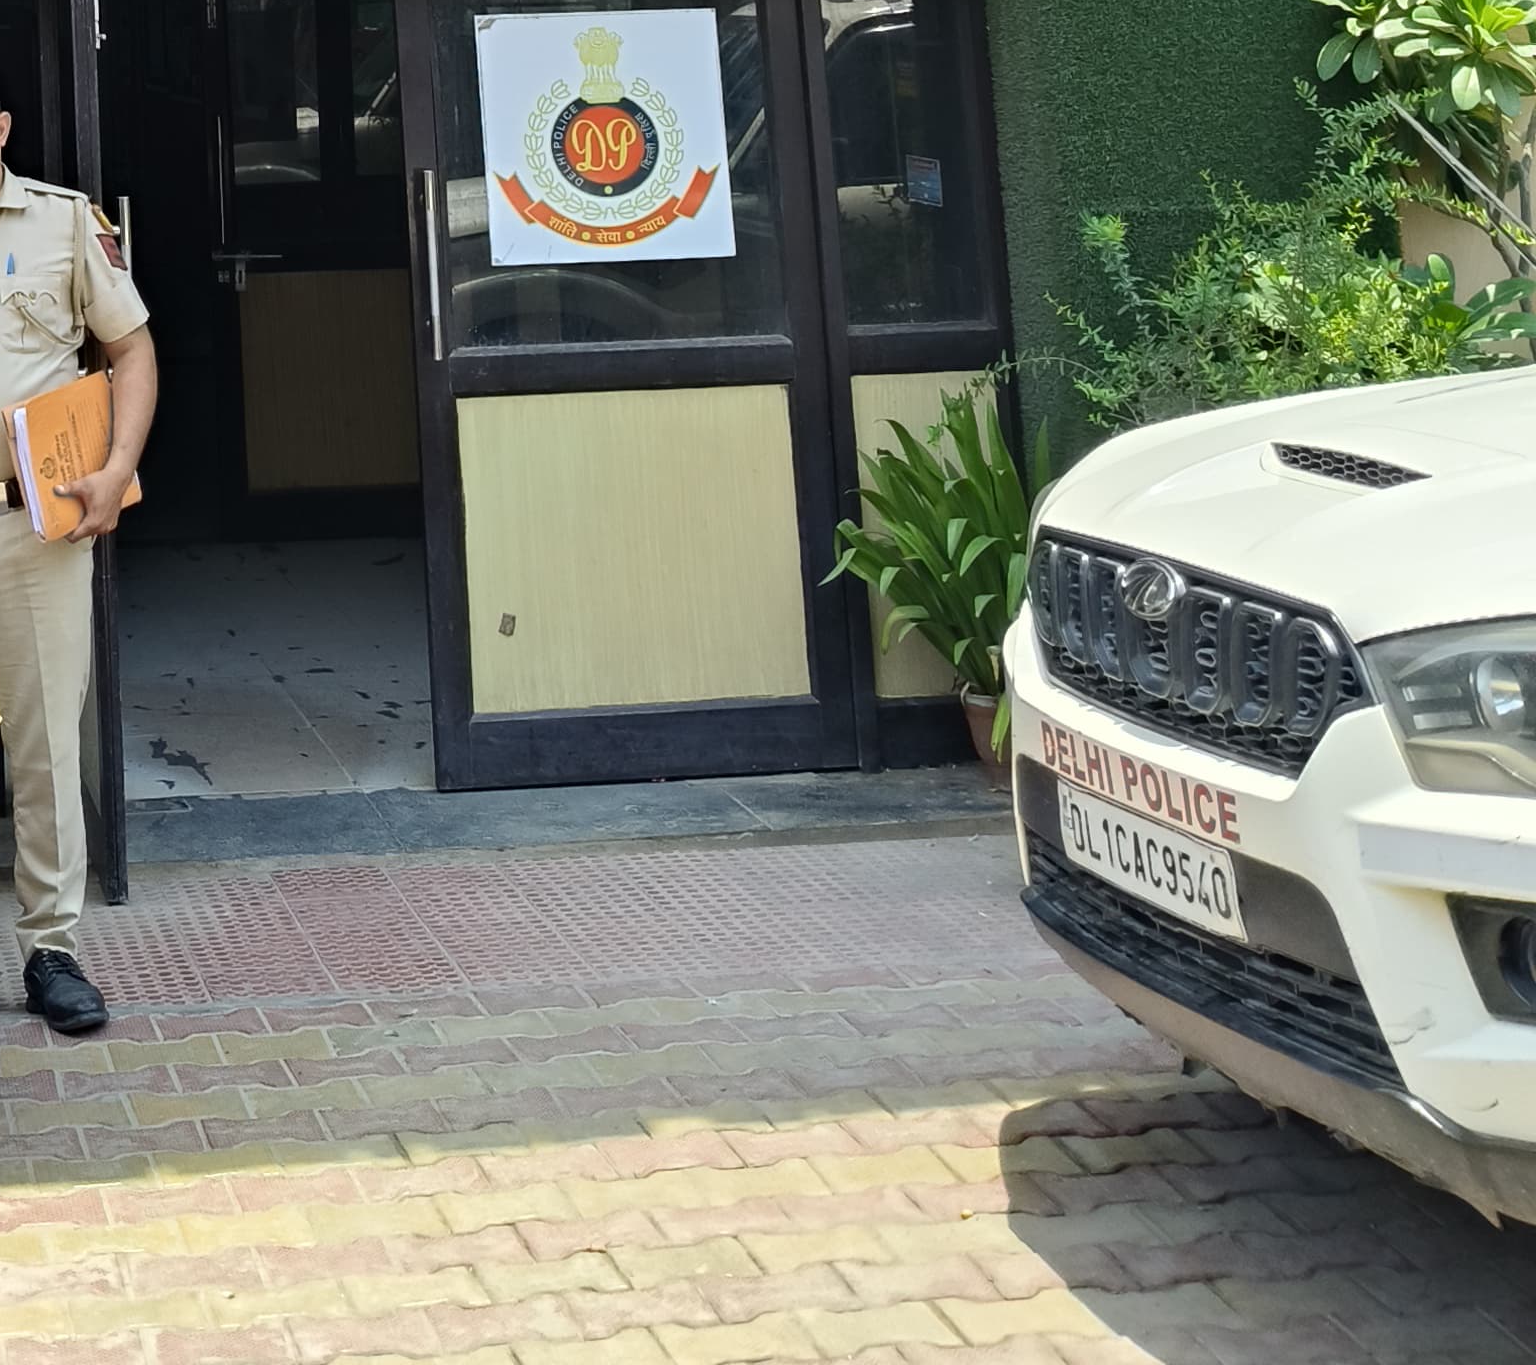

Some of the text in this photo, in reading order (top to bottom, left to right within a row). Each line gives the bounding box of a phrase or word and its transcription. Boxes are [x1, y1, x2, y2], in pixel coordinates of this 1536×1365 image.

[553, 105, 583, 187] DELHI POLICE
[640, 143, 656, 170] दिल्ली
[548, 215, 666, 243] शांति सेवा न्याय
[1041, 721, 1115, 796] DELHI
[1121, 755, 1241, 844] POLICE
